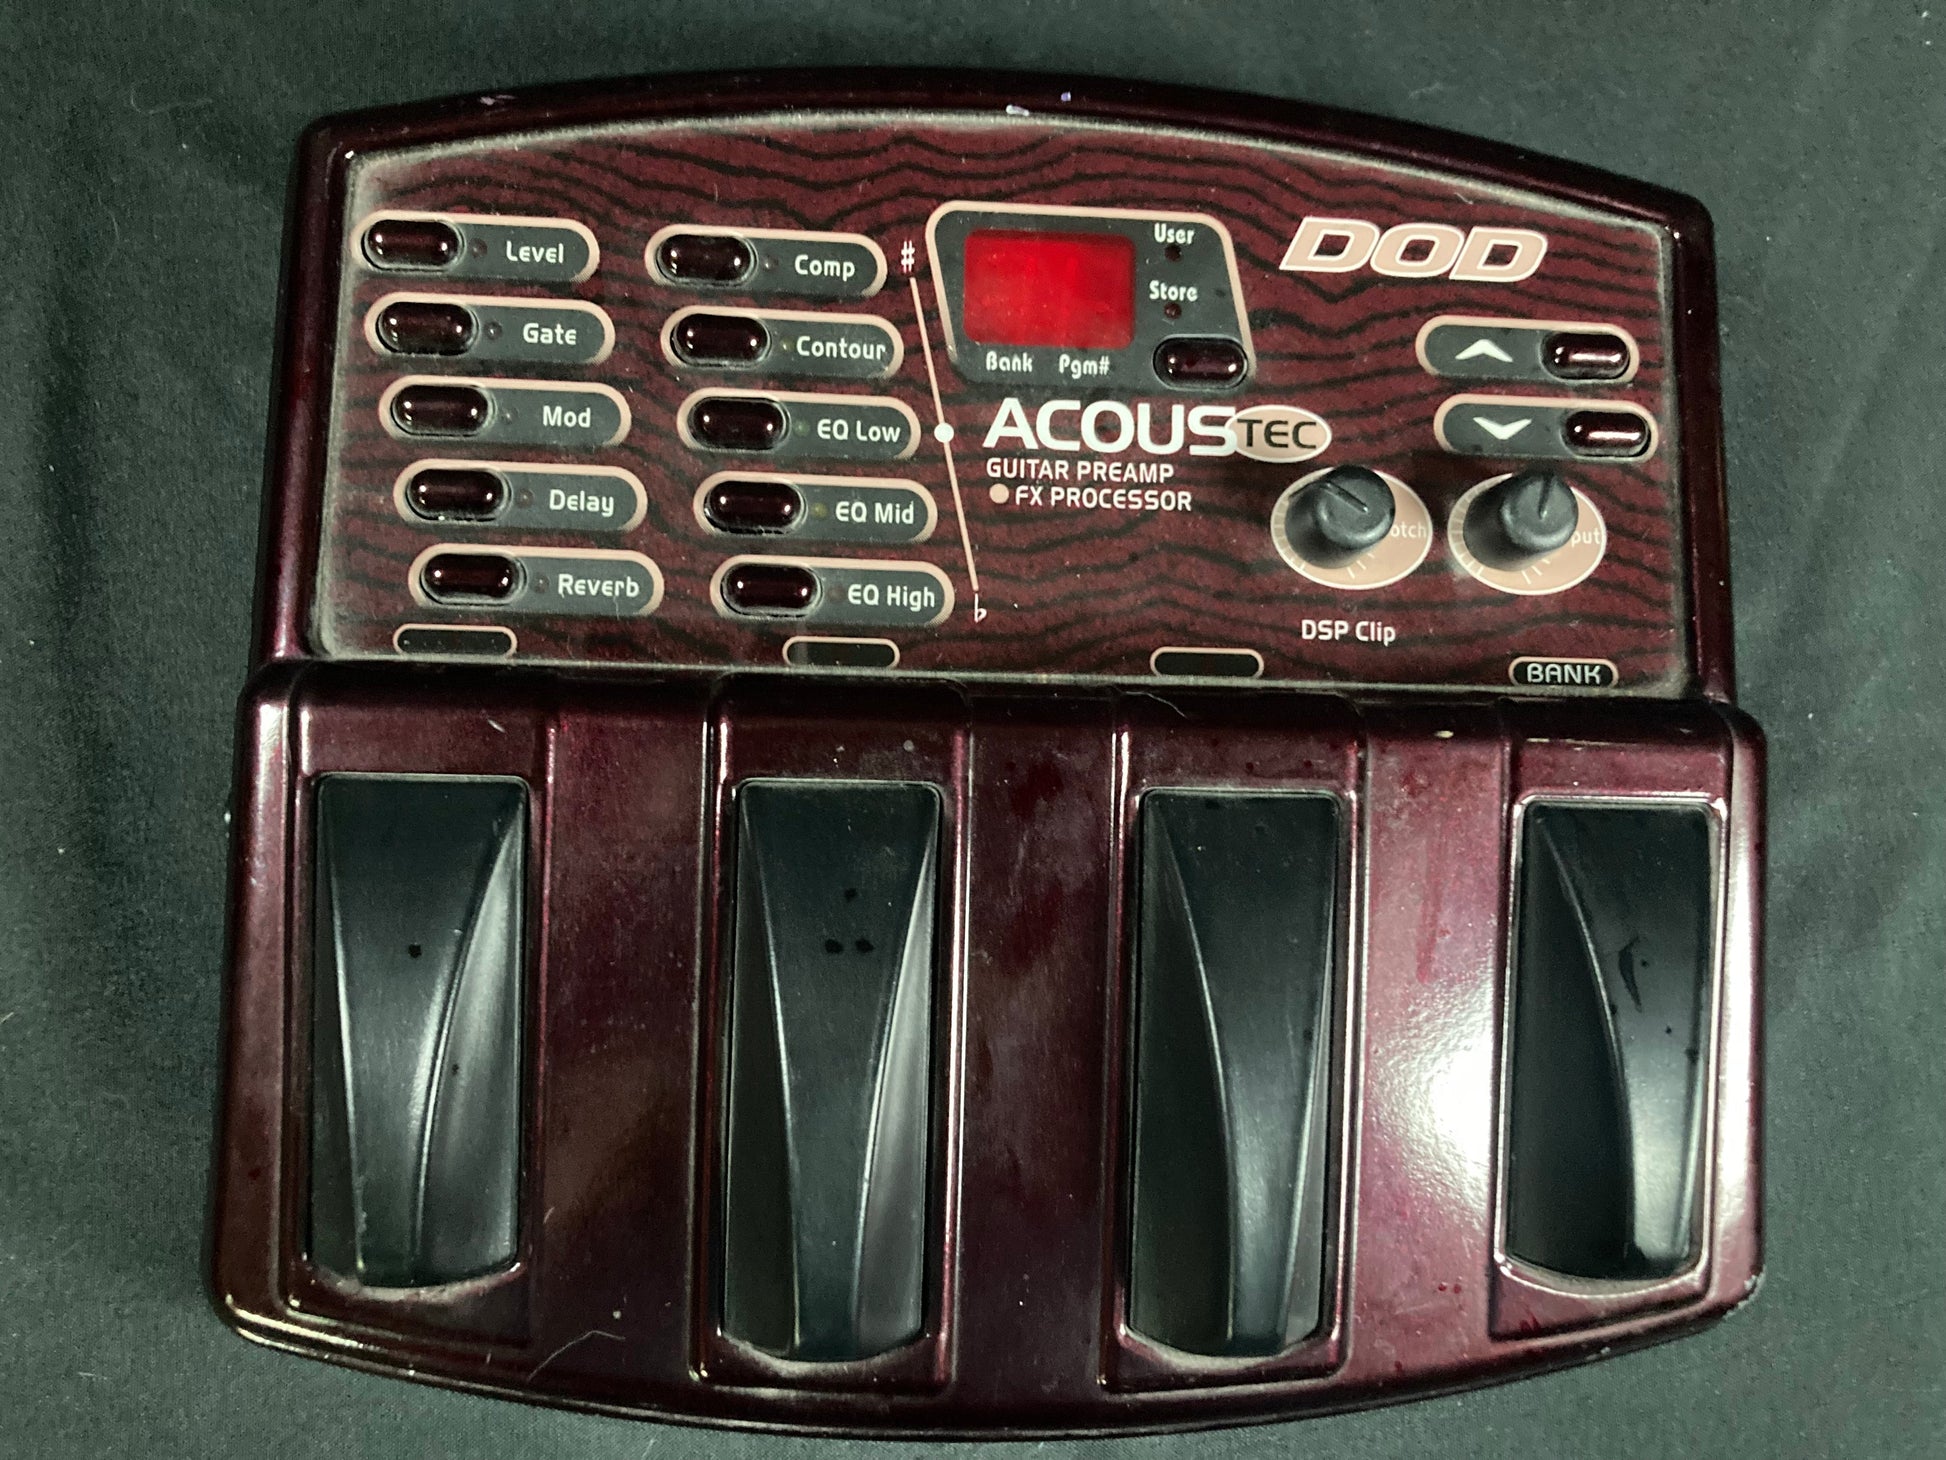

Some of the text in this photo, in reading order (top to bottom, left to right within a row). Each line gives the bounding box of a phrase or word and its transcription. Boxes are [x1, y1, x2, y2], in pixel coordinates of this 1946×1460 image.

[1154, 222, 1195, 245] User
[506, 241, 564, 263] Level
[1278, 216, 1548, 283] DOD
[794, 255, 856, 281] Comp
[1149, 280, 1198, 302] Store
[522, 322, 578, 345] Gate
[796, 336, 887, 360] Contour
[985, 351, 1033, 373] Bank
[1058, 353, 1110, 379] Pgm#
[543, 406, 591, 428] Mod
[816, 419, 901, 443] EQ Low
[986, 457, 1174, 484] GUITAR PREAMP
[549, 489, 615, 517] Delay
[1015, 485, 1192, 511] FX PROCESSOR
[835, 501, 915, 525] EQ Mid
[1390, 521, 1427, 539] otch
[557, 573, 640, 597] Reverb
[848, 585, 935, 613] EQ High
[1301, 619, 1397, 646] DSP Clip
[1526, 663, 1602, 685] BANK
